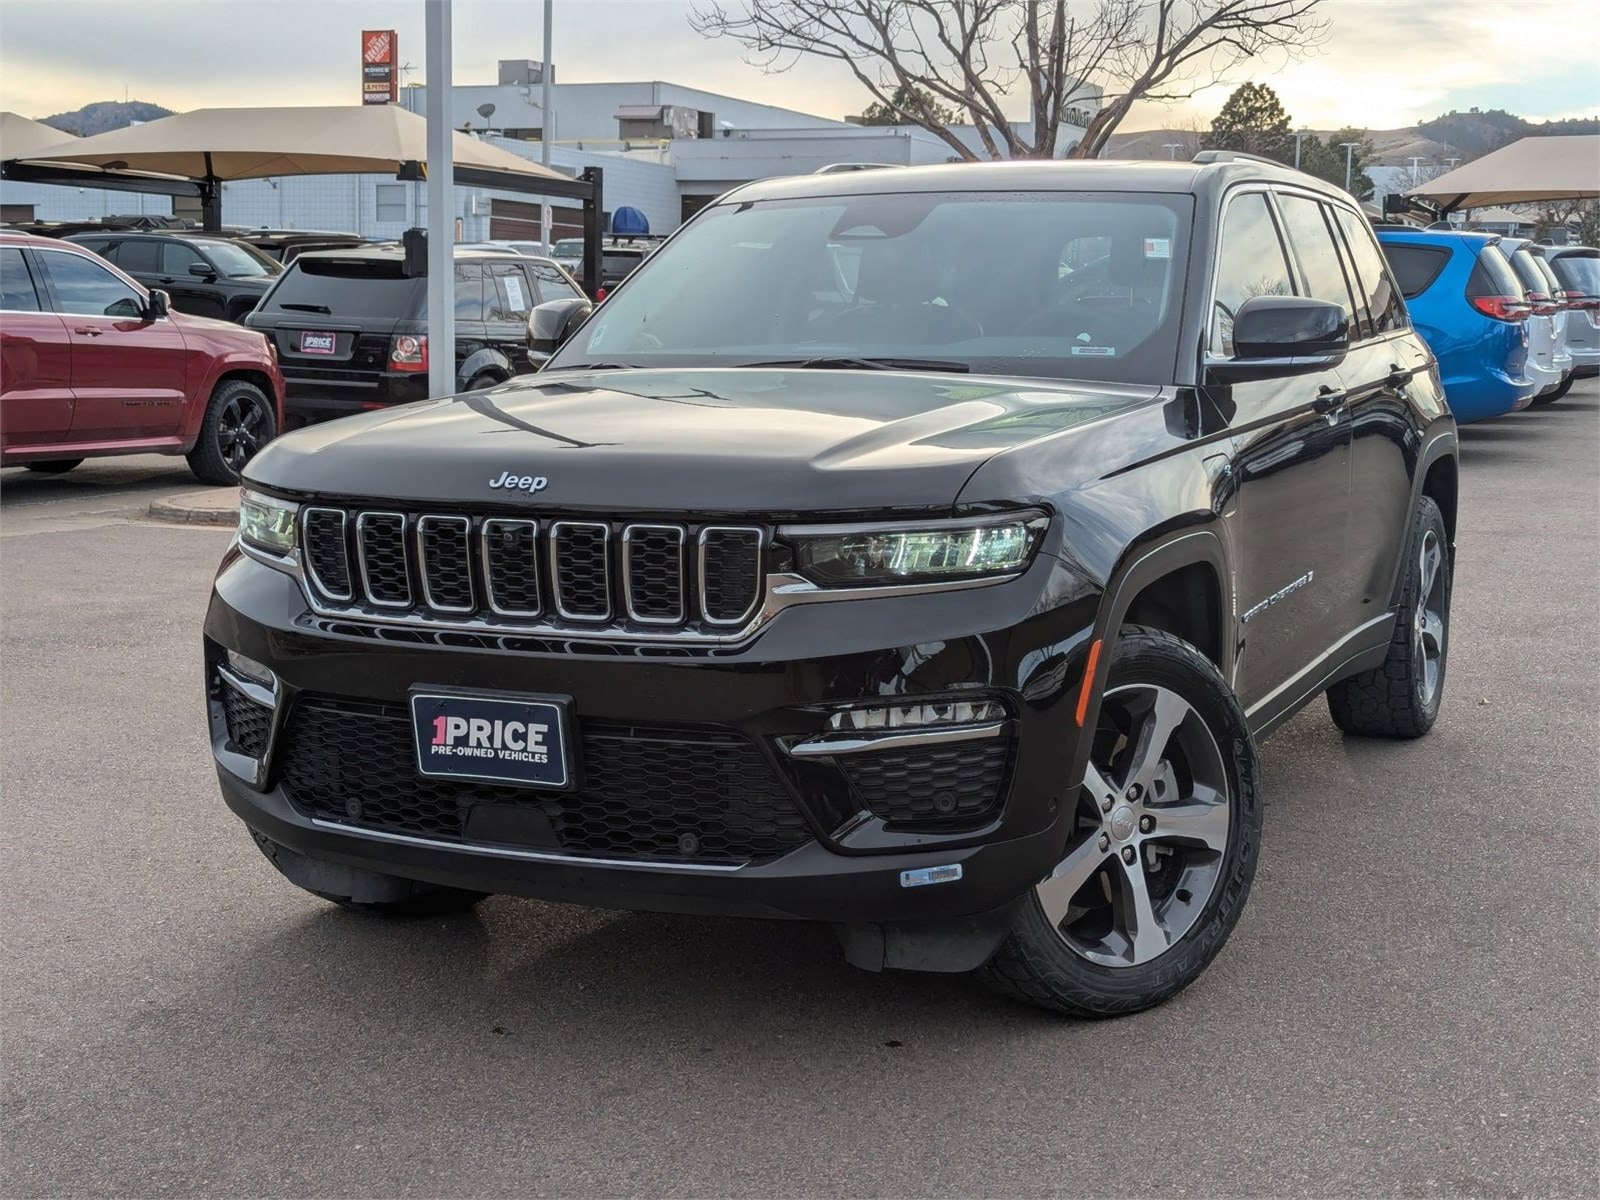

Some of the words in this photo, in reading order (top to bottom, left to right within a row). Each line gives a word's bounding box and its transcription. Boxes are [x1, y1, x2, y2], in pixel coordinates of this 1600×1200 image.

[364, 33, 390, 63] HOME
[489, 471, 548, 493] Jeep
[431, 715, 549, 754] 1PRICE
[431, 745, 495, 758] PRE-OWNED
[498, 750, 548, 764] VEHICLES
